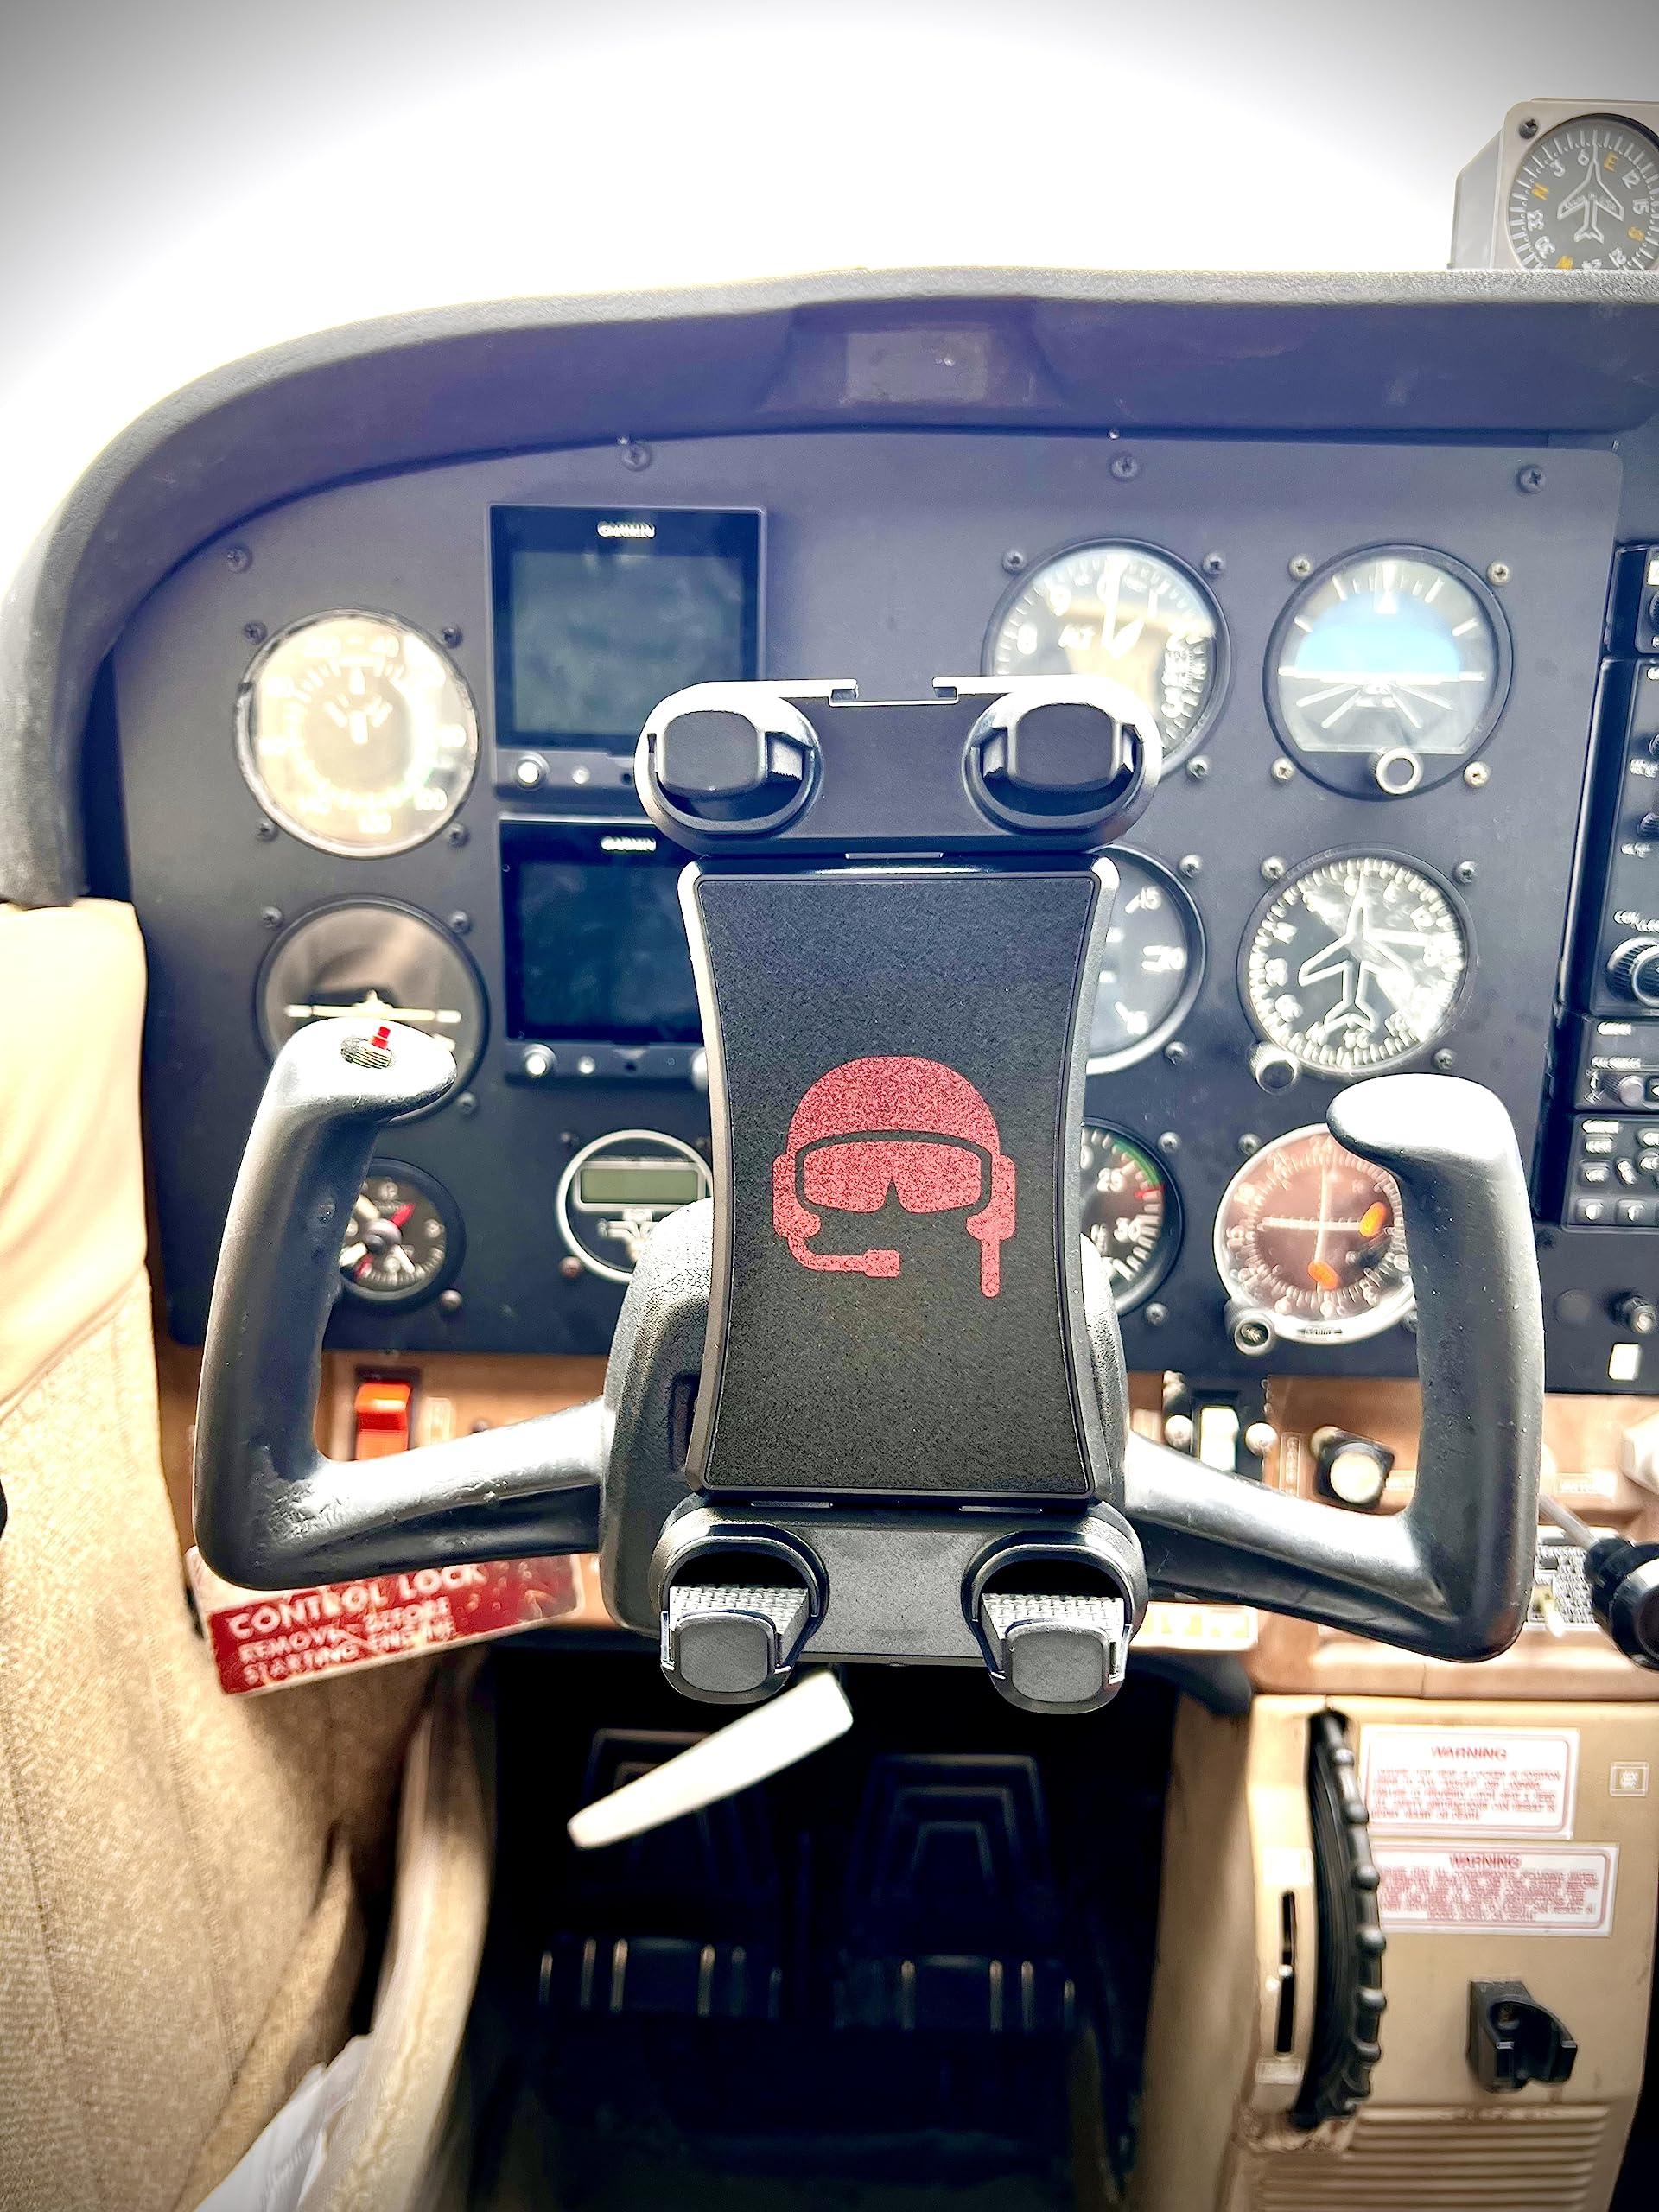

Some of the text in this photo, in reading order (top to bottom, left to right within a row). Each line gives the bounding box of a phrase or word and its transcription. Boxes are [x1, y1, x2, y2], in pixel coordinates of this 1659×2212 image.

[1603, 153, 1618, 172] E
[1530, 182, 1549, 200] N
[398, 1564, 486, 1600] LOCK
[1431, 1745, 1507, 1760] WARNING
[1449, 1853, 1522, 1869] WARNING
